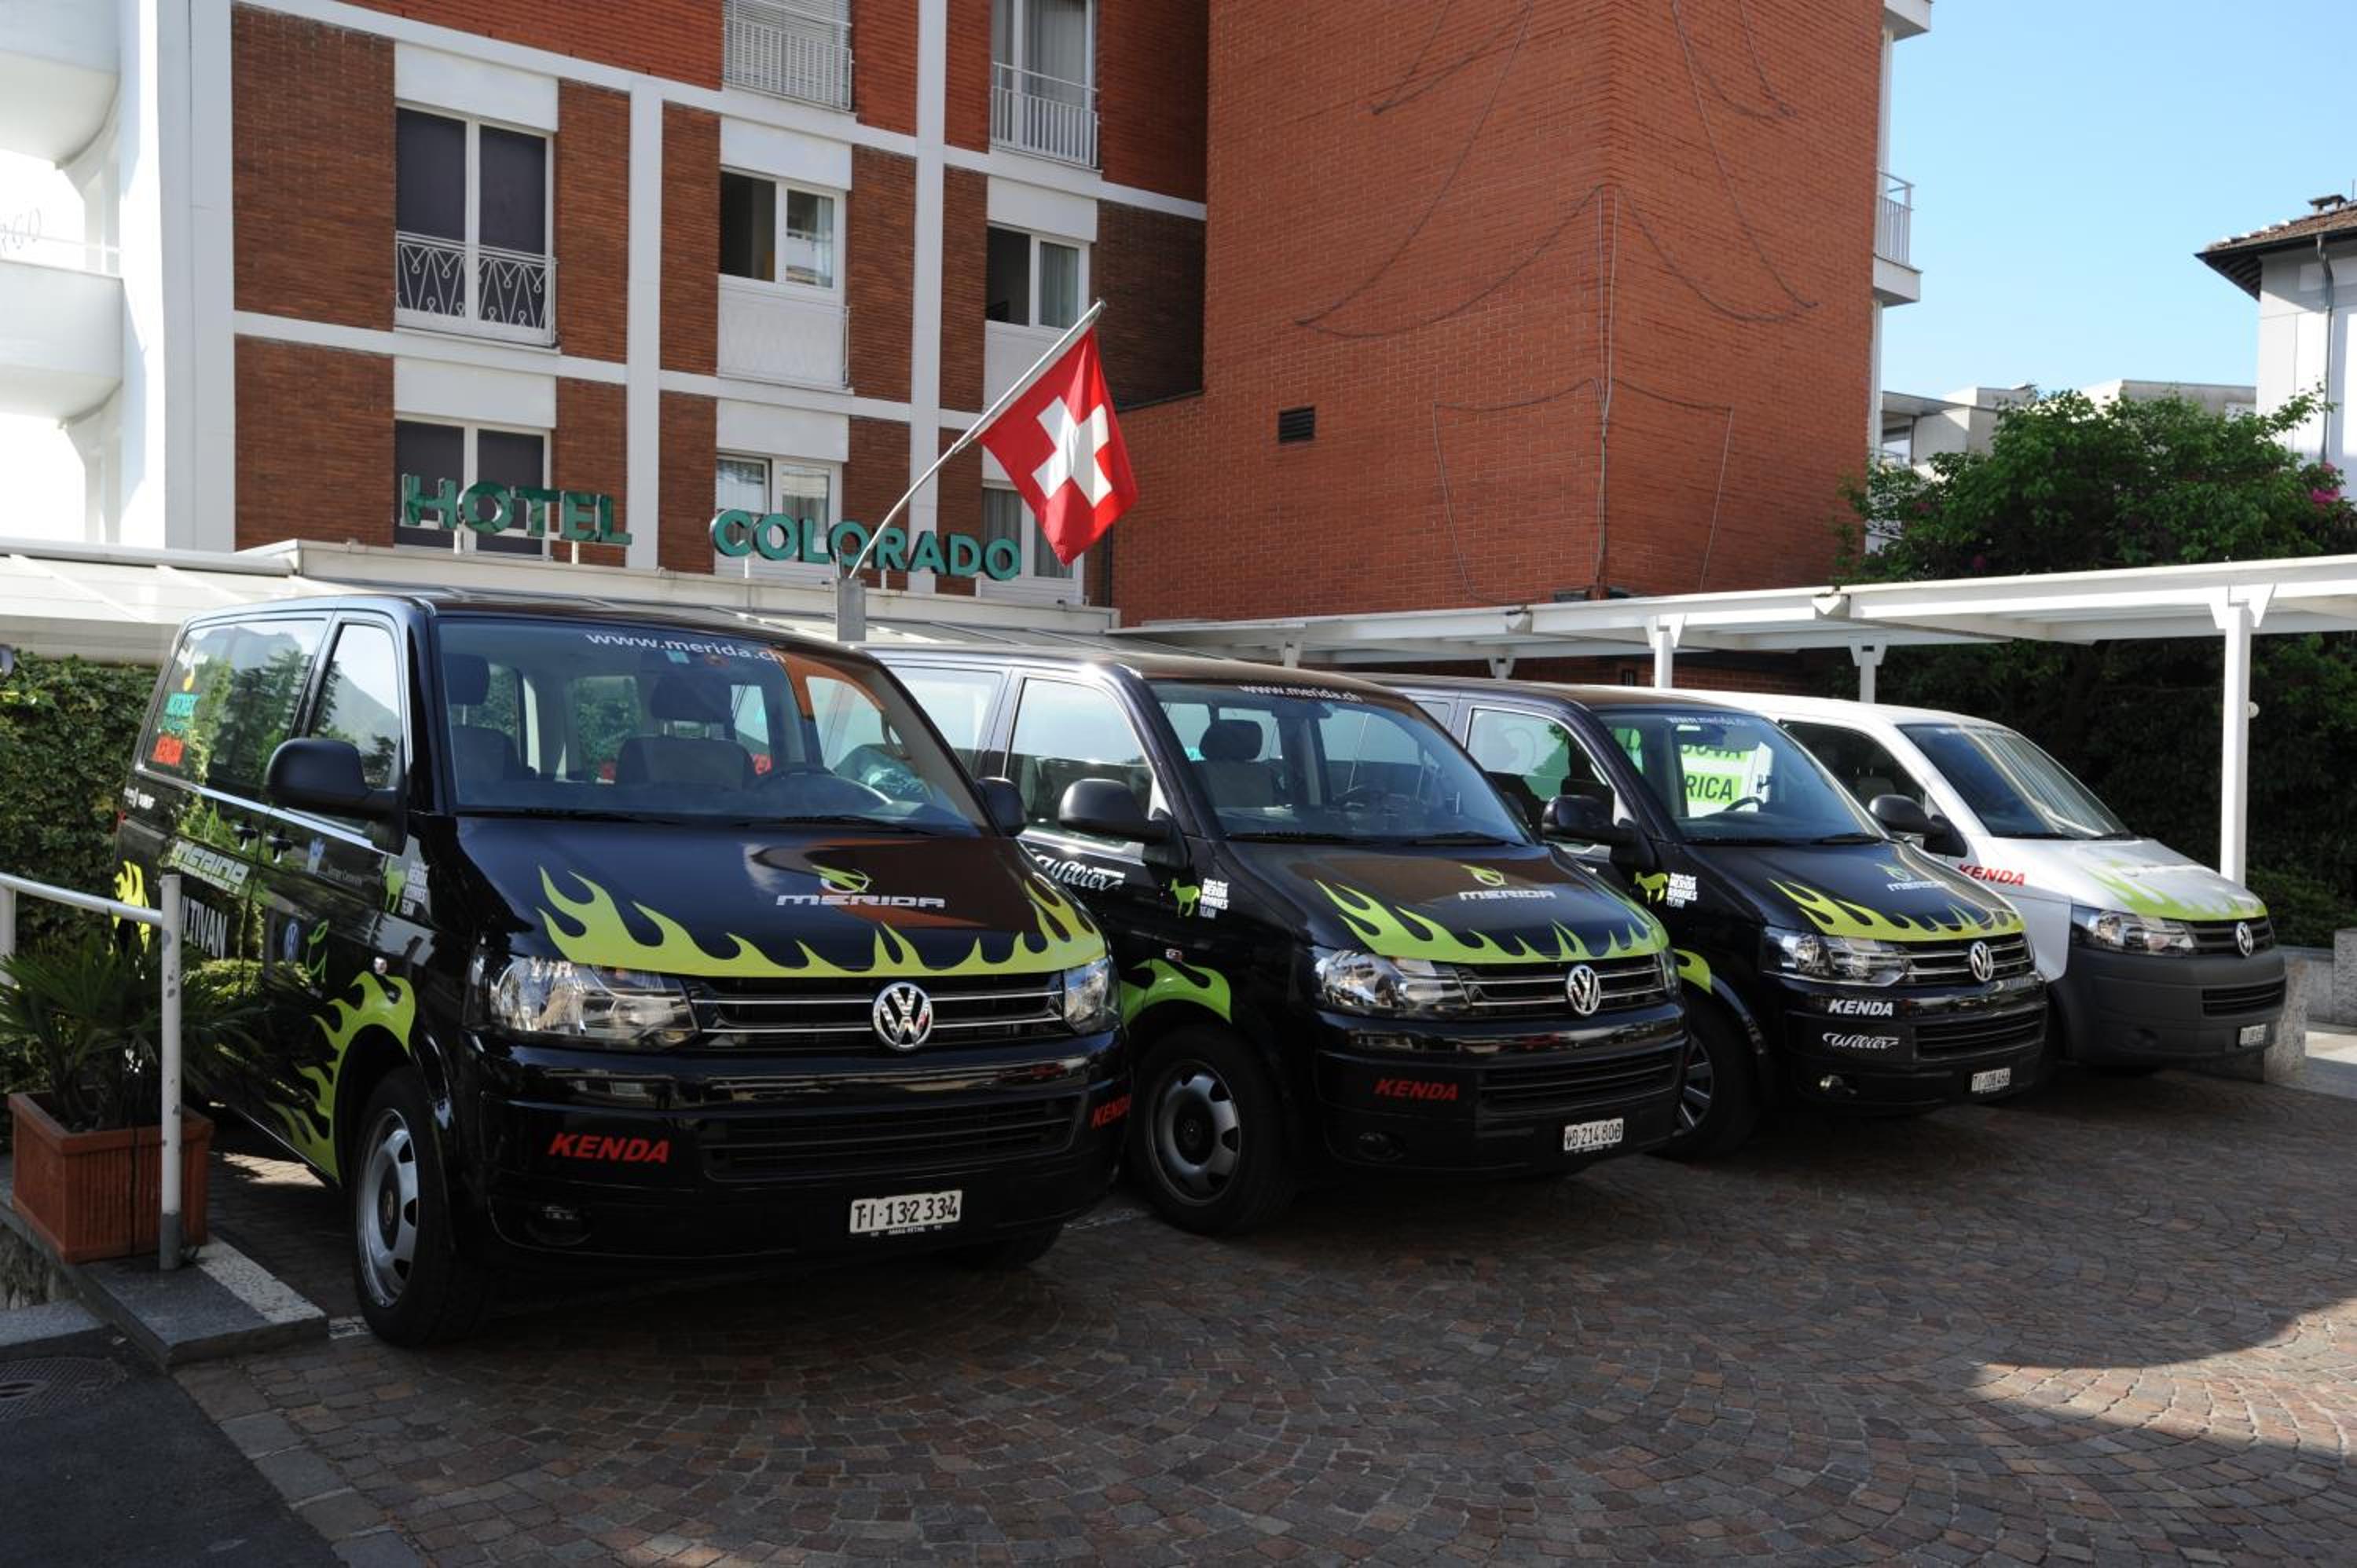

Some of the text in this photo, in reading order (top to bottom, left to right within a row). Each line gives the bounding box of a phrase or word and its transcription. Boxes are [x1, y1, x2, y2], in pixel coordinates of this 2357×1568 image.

[401, 474, 1021, 581] HOTEL COLORADO
[586, 633, 786, 663] www.merida.ch
[776, 895, 945, 907] MERIDA
[1458, 889, 1557, 901] MERIDA
[1828, 998, 1894, 1017] KENDA
[1374, 1079, 1459, 1101] KENDA
[548, 1132, 669, 1164] KENDA
